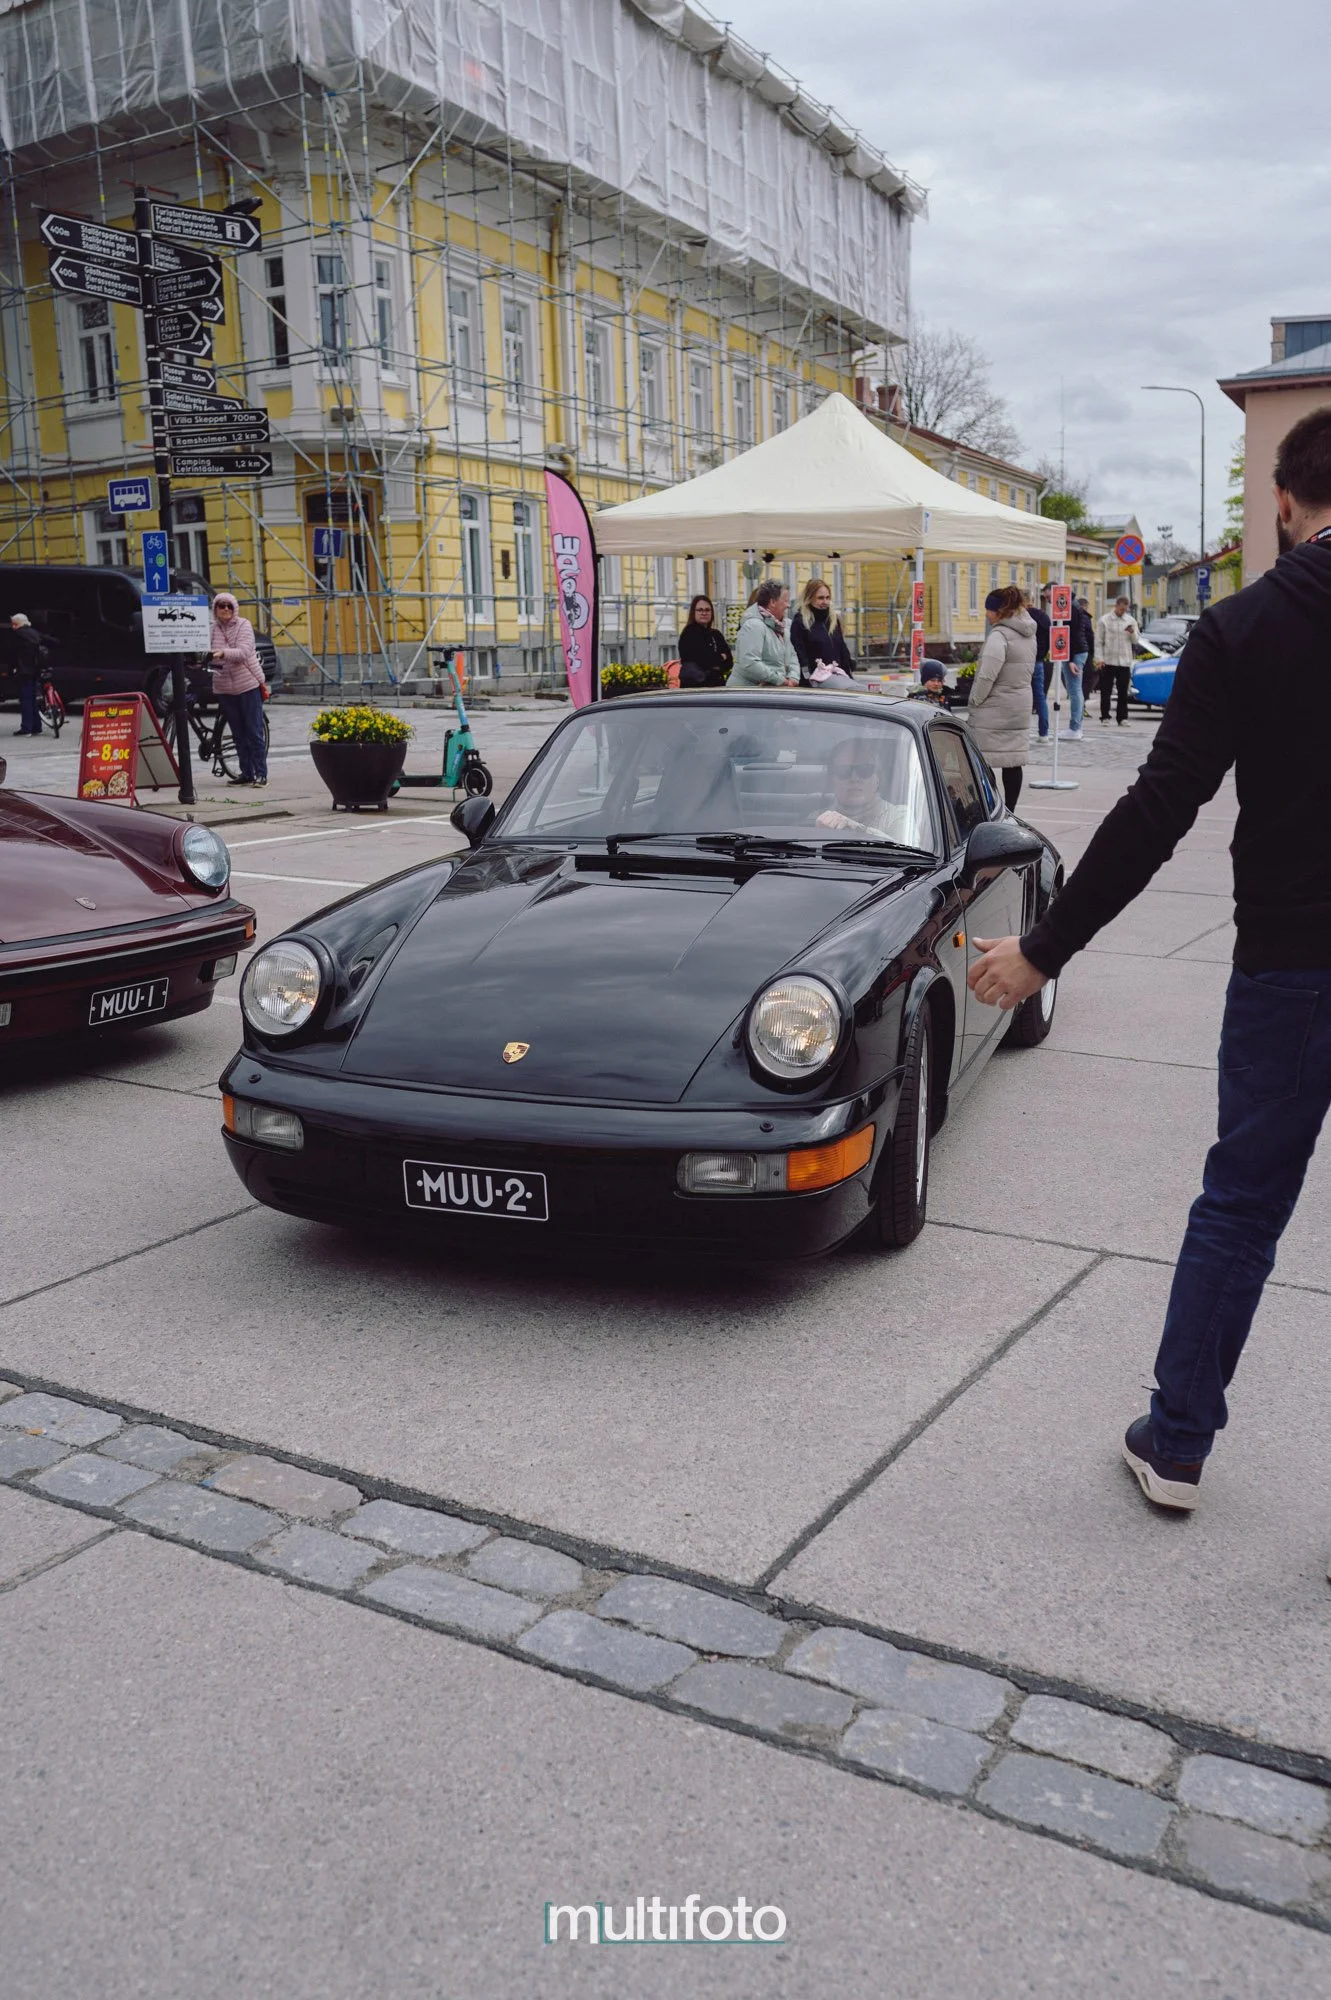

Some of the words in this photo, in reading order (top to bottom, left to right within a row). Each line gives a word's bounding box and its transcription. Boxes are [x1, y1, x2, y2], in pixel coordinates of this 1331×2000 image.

[155, 207, 216, 224] Turistinformation
[50, 226, 70, 237] 400m
[156, 222, 181, 232] Tourist
[112, 249, 126, 258] park
[86, 282, 103, 292] Guest
[104, 286, 127, 298] harbour
[170, 290, 186, 298] Town
[160, 318, 178, 326] Kyrka
[161, 325, 180, 333] Kirkko
[162, 332, 181, 340] Church
[164, 366, 186, 376] Museum
[194, 415, 227, 424] Skeppet
[176, 435, 227, 445] Ramsholmen
[232, 434, 242, 442] 1,2
[422, 1169, 527, 1212] MUU-2
